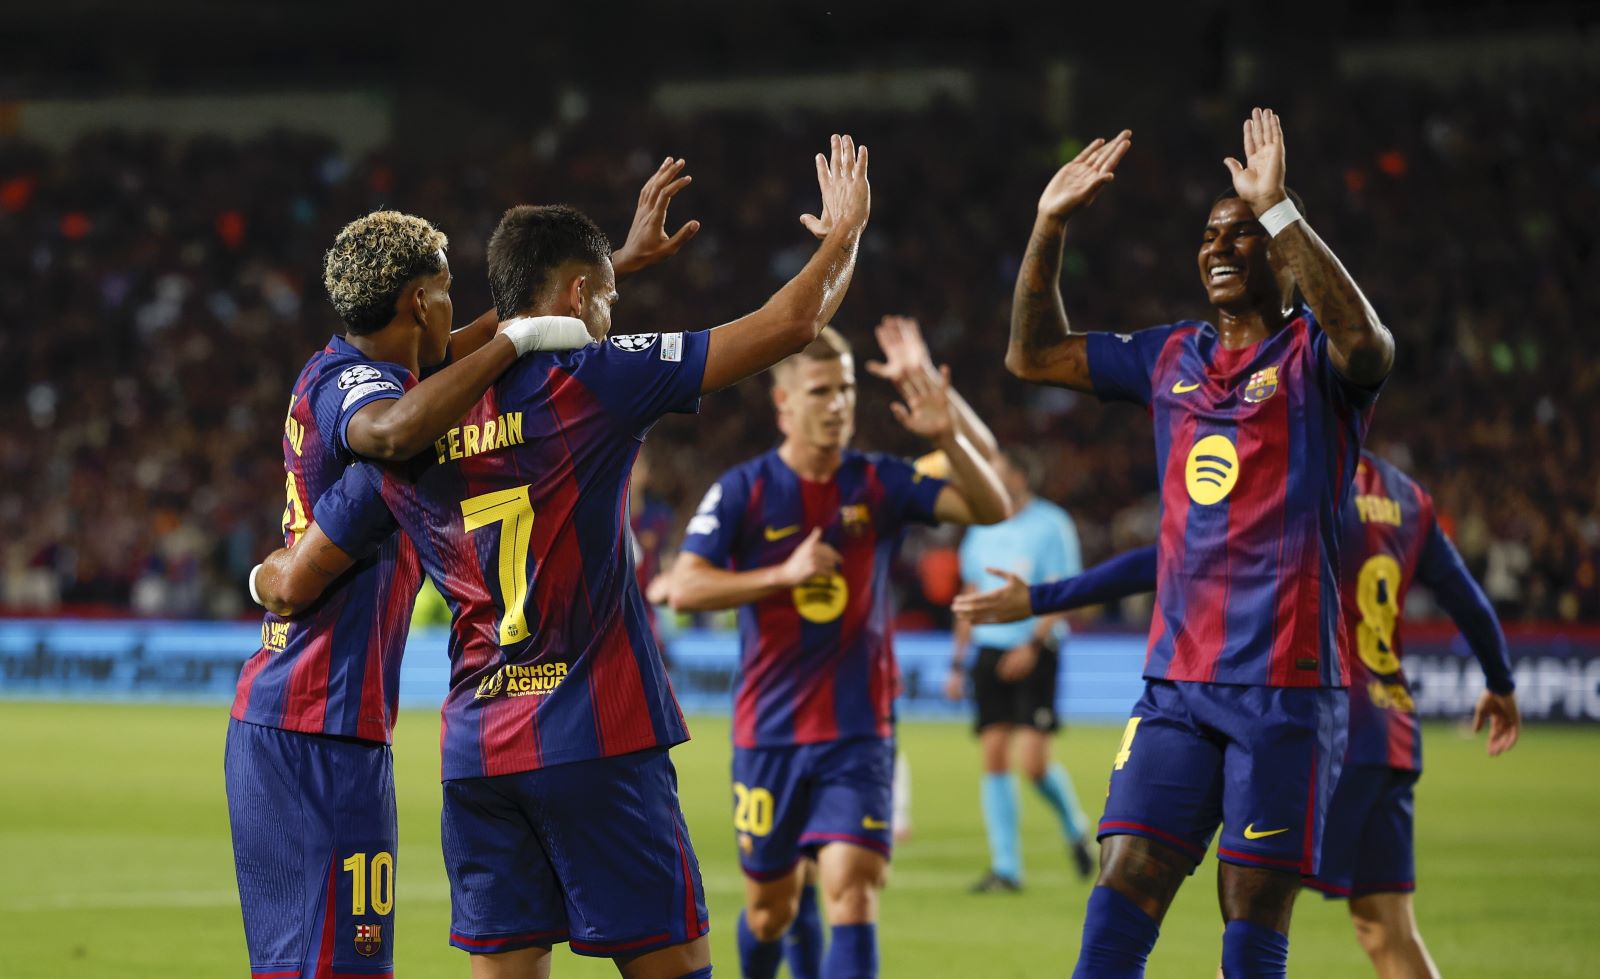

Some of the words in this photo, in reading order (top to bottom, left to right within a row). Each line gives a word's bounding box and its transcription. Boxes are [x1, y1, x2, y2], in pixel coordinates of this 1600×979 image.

[435, 412, 524, 464] FERRAN
[460, 484, 534, 646] 7
[1357, 555, 1401, 674] 8
[506, 663, 567, 677] UNHCR
[732, 782, 774, 836] 20
[343, 852, 393, 916] 10
